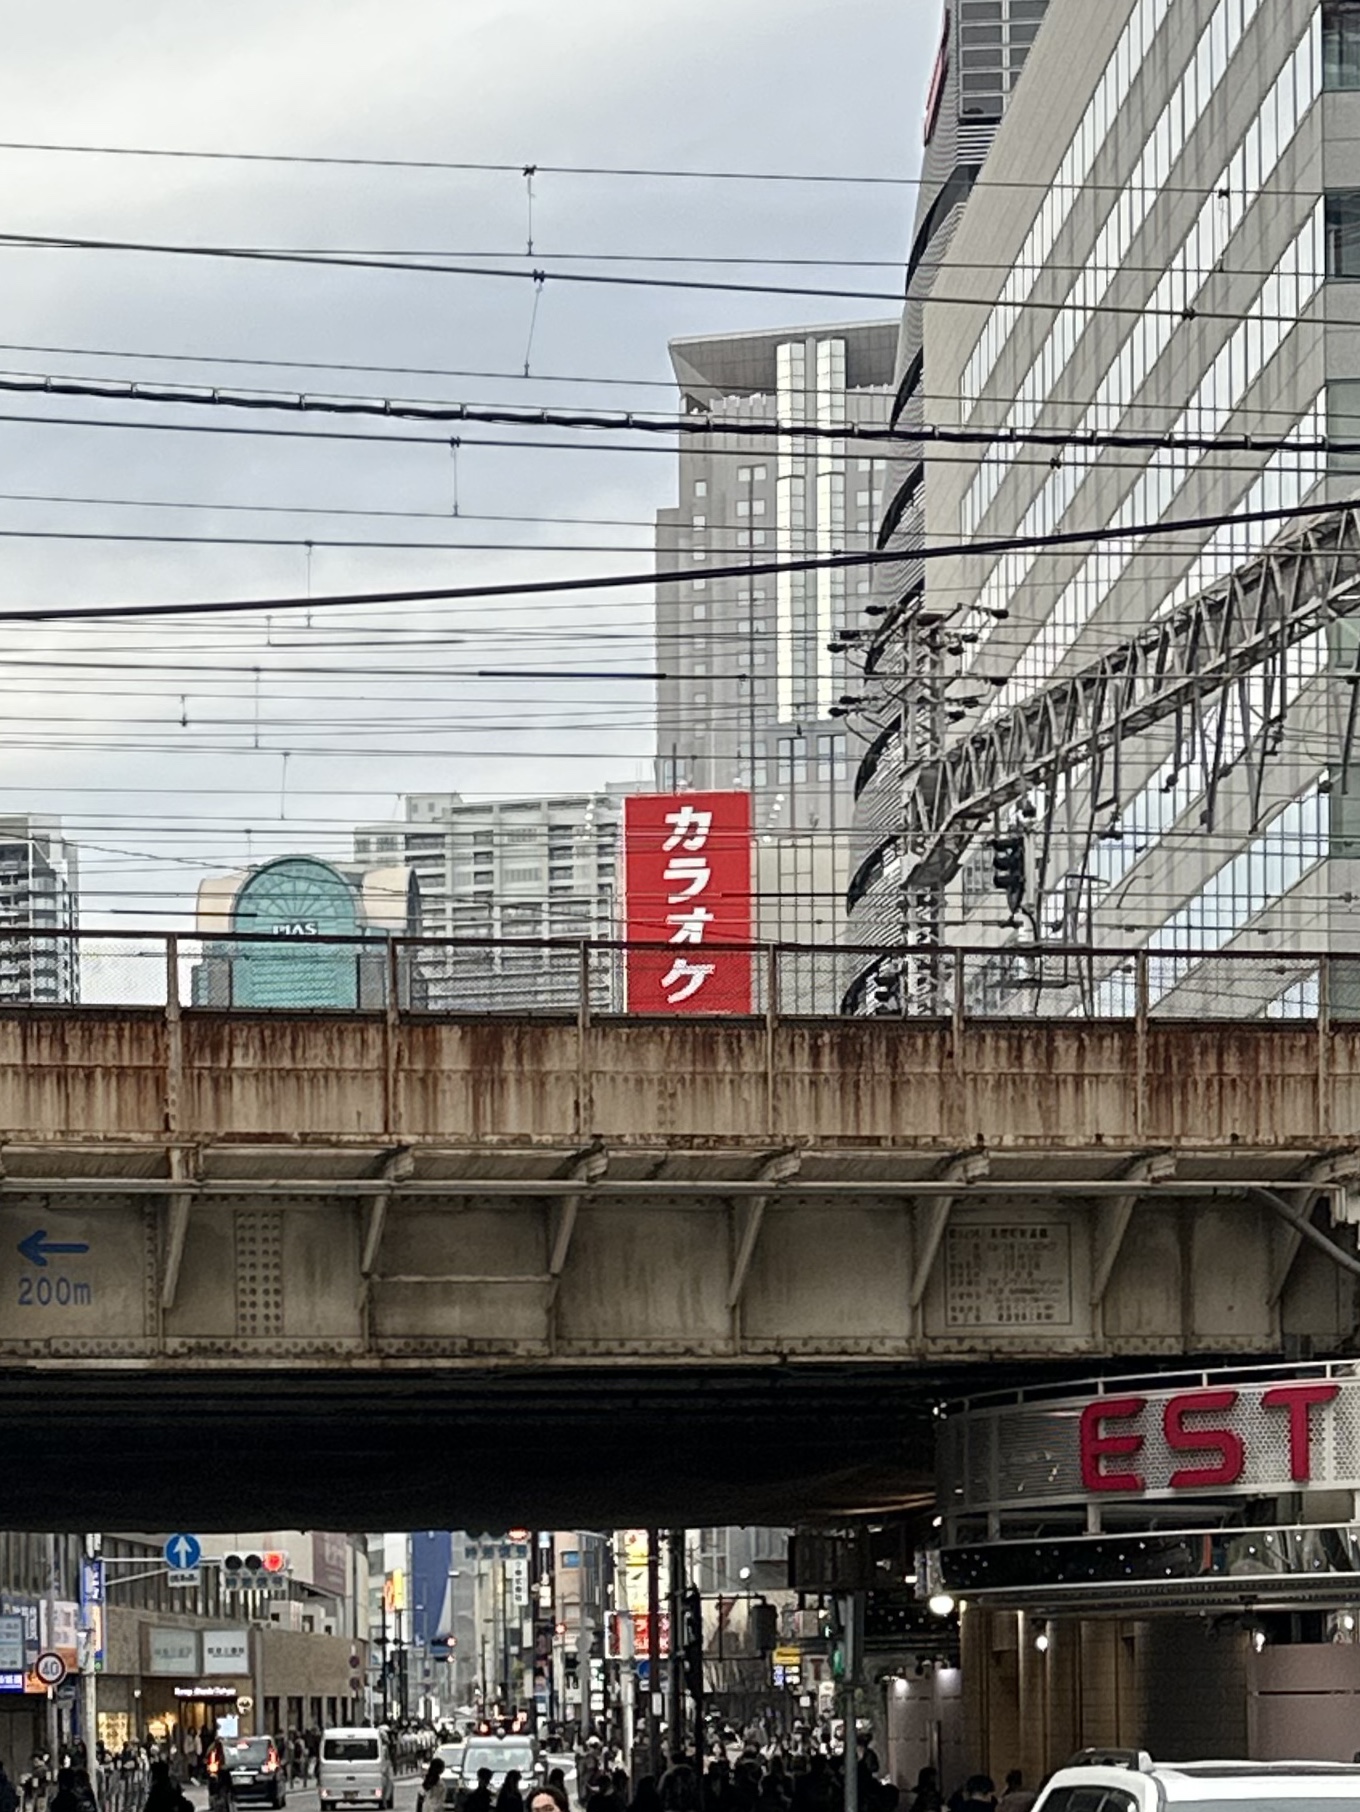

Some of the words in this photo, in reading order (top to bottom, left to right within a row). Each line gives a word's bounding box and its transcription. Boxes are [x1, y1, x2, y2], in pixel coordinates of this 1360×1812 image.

[660, 805, 716, 1004] カラオケ
[17, 1277, 92, 1306] 200m
[1080, 1385, 1341, 1492] EST
[42, 1661, 59, 1675] 40
